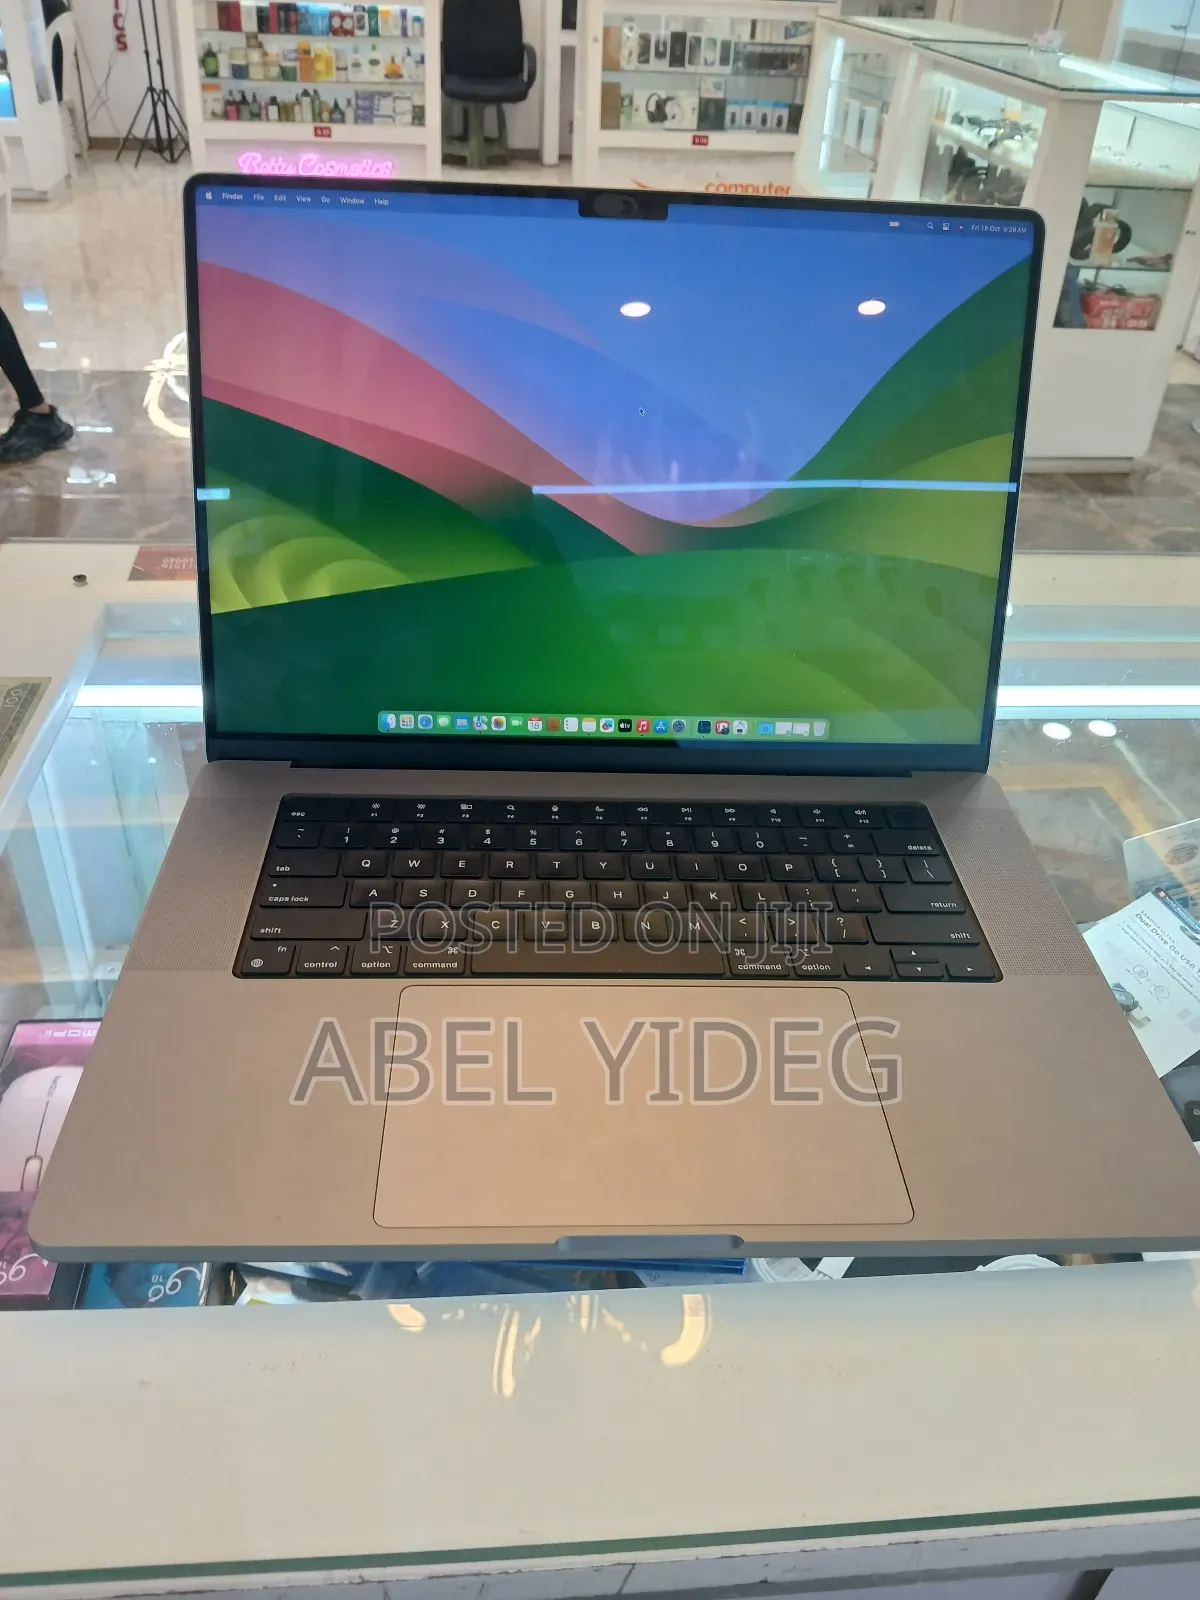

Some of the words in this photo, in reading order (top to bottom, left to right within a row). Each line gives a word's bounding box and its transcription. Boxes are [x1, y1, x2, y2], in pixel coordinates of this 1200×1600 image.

[222, 192, 243, 200] Finder
[274, 194, 287, 202] Edit
[296, 195, 311, 203] View
[340, 196, 365, 205] Window
[374, 198, 389, 206] Help
[530, 721, 540, 730] 18
[390, 836, 398, 844] 2
[437, 837, 445, 845] 3
[483, 837, 491, 845] 4
[529, 838, 537, 846] 5
[575, 838, 583, 846] 6
[666, 839, 674, 847] 8
[711, 840, 719, 848] 9
[361, 859, 371, 868] Q
[408, 859, 421, 868] W
[458, 860, 466, 868] E
[506, 861, 514, 869] R
[553, 861, 561, 869] T
[599, 861, 607, 869] Y
[645, 862, 655, 870] U
[738, 863, 748, 872] O
[784, 864, 793, 872] P
[368, 889, 378, 897] A
[419, 889, 428, 897] S
[468, 889, 477, 898] D
[518, 890, 525, 898] F
[565, 890, 574, 899] G
[613, 891, 622, 899] H
[662, 891, 669, 899] J
[709, 892, 719, 900] K
[757, 892, 766, 900] L
[268, 895, 289, 903] caps
[930, 900, 957, 908] return
[389, 920, 399, 928] Z
[440, 920, 449, 929] X
[491, 921, 500, 929] C
[591, 921, 600, 930] B
[640, 921, 650, 930] N
[689, 922, 701, 930] M
[259, 926, 282, 934] shift
[1135, 912, 1152, 929] Dual
[1151, 927, 1169, 945] Drive
[361, 960, 391, 969] option
[412, 961, 458, 969] command
[802, 963, 830, 971] option
